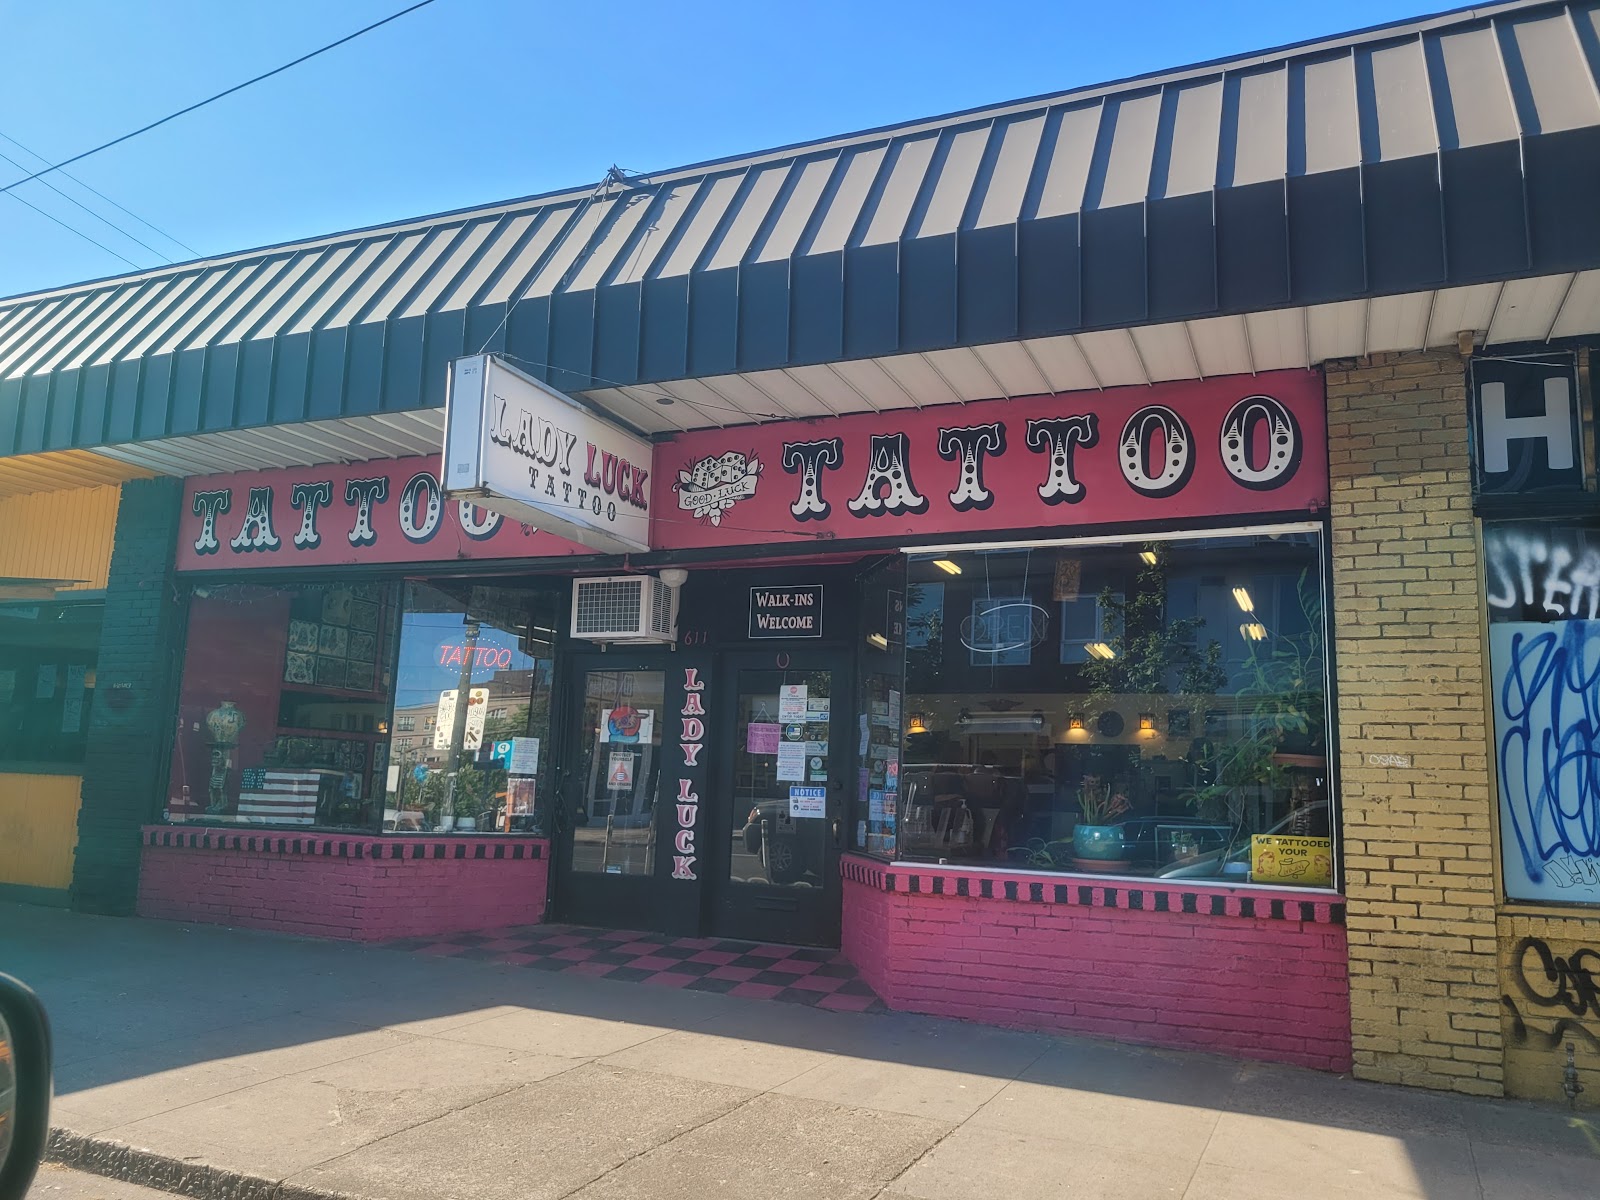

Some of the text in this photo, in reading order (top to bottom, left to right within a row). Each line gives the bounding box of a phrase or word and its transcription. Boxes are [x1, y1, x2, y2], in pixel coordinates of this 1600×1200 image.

[1481, 377, 1574, 473] H
[490, 394, 648, 511] LADY LUCK
[781, 394, 1303, 521] TATTOO
[529, 466, 616, 522] TATTOO
[684, 481, 750, 507] GOOD LUCK
[193, 471, 505, 555] TATTOO
[755, 592, 815, 608] WALK-INS
[756, 614, 814, 630] WELCOME
[960, 614, 1048, 642] OPEN
[684, 630, 707, 646] 611
[440, 645, 511, 667] TATTOO
[680, 668, 705, 766] LADY
[794, 788, 822, 797] NOTICE
[671, 779, 699, 881] LUCK
[1256, 836, 1330, 848] WE TATTOOED
[1278, 848, 1308, 857] YOUR
